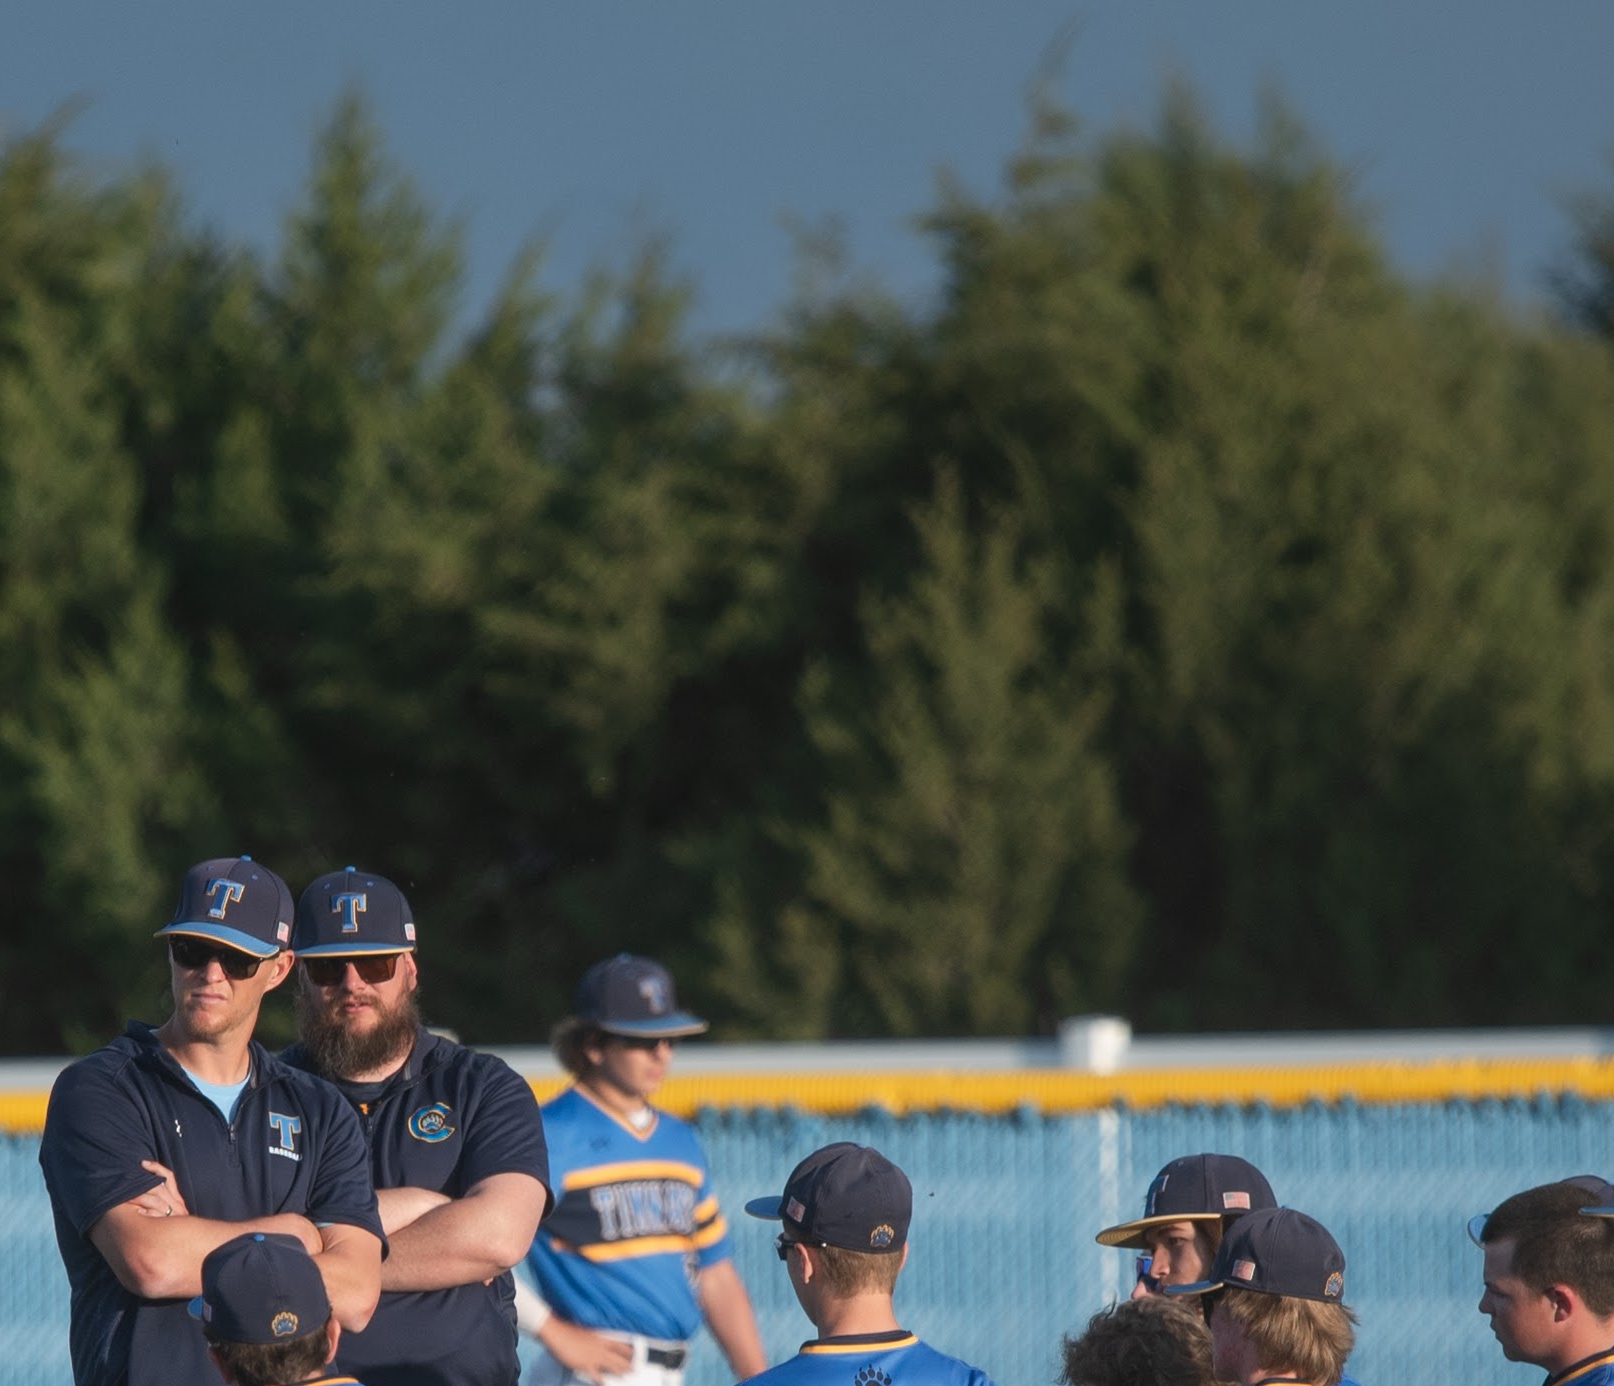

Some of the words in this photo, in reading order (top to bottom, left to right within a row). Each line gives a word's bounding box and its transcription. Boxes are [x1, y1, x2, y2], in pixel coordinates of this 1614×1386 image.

[206, 878, 246, 920] T
[331, 892, 367, 933] T
[269, 1111, 302, 1151] T
